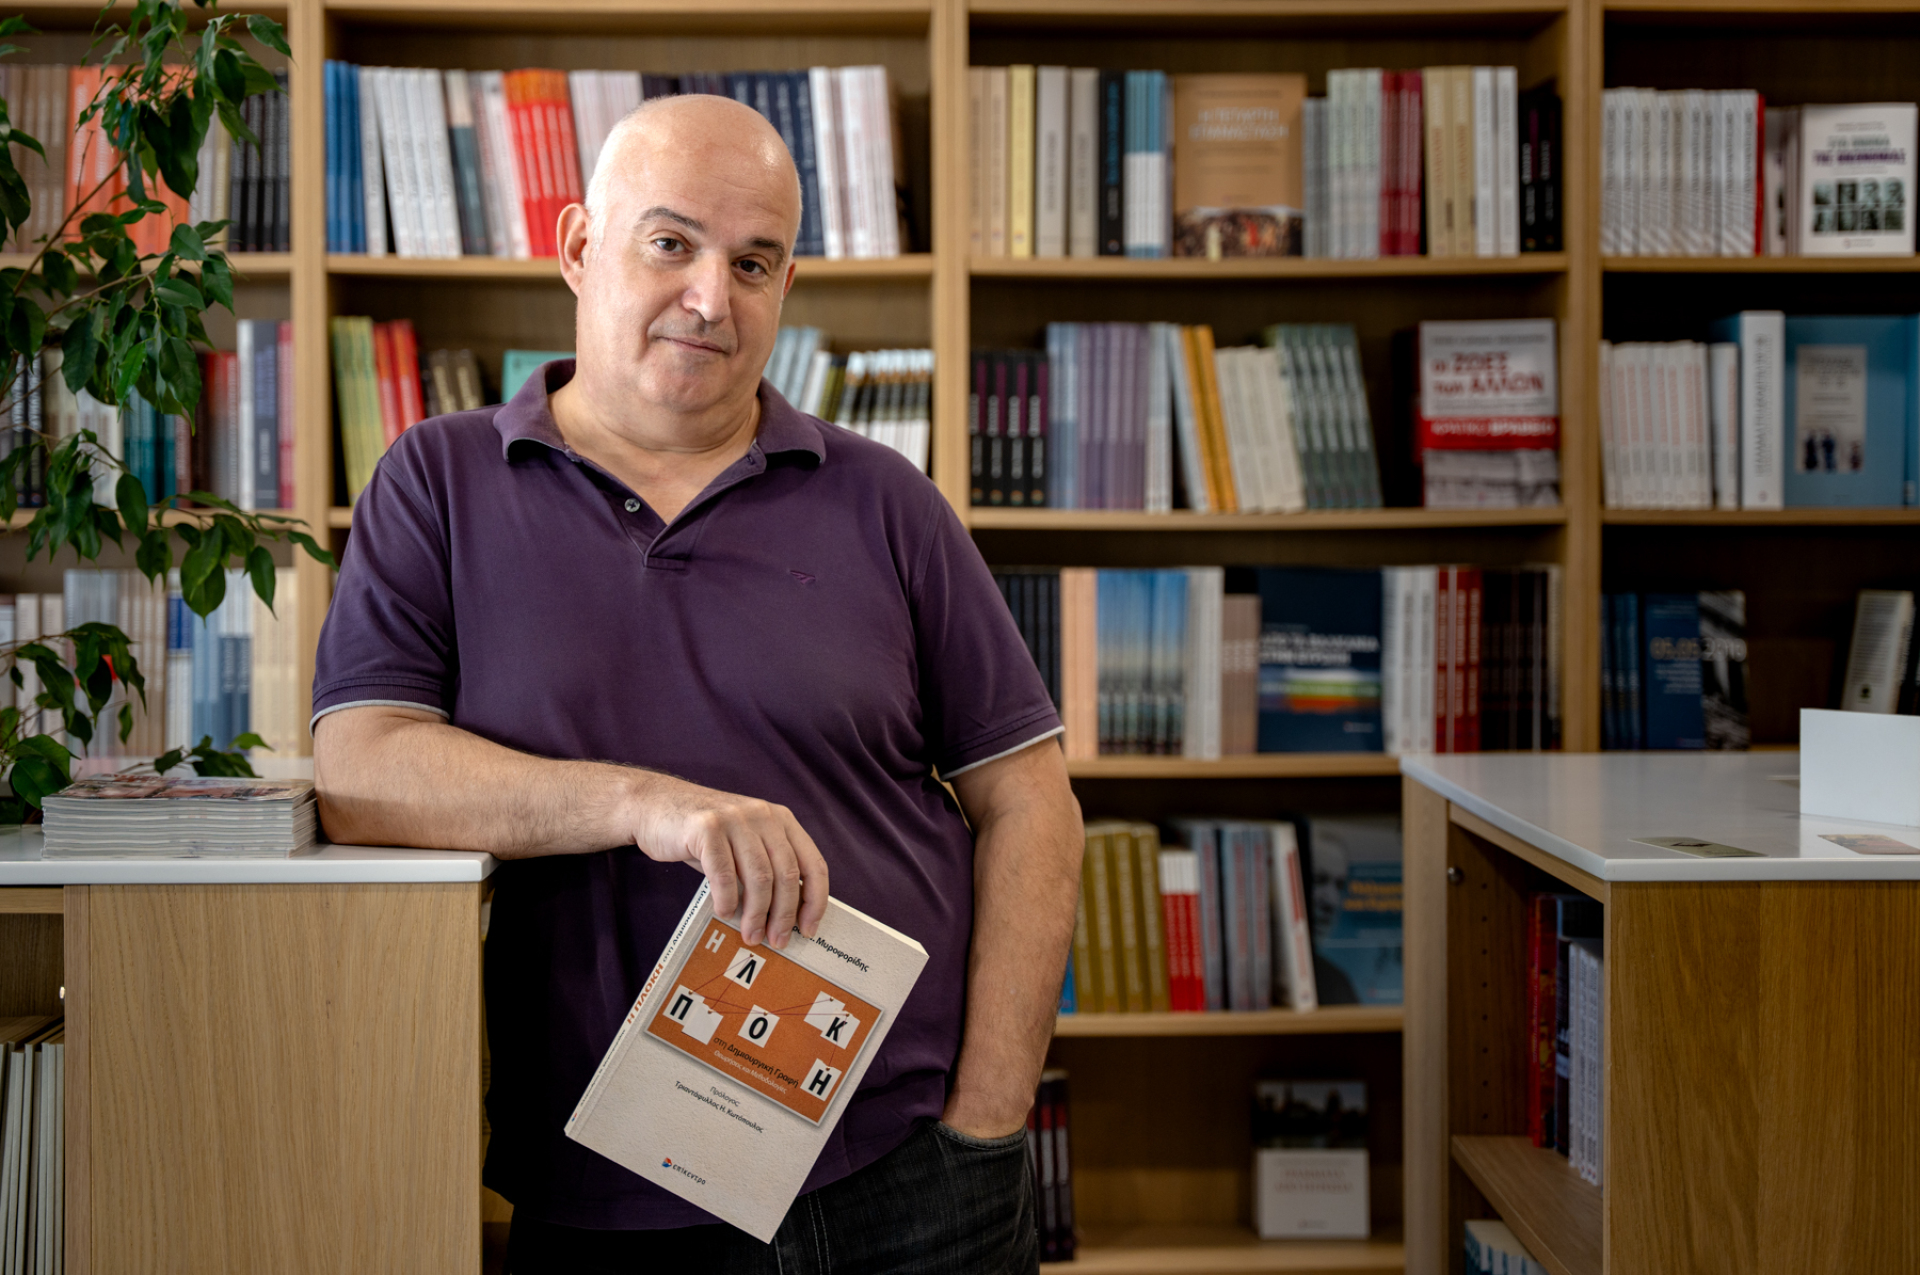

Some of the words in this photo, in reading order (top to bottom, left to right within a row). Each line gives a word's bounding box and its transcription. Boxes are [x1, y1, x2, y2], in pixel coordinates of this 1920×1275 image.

[1470, 371, 1544, 394] ΑΛΛΩΝ
[705, 929, 726, 954] Η
[815, 937, 869, 972] Μυροφορίδης
[736, 959, 757, 984] Λ
[627, 1012, 636, 1025] Η
[634, 963, 664, 1012] ΠΛΟΚΗ
[669, 993, 694, 1021] Π
[748, 1016, 769, 1040] Ο
[825, 1017, 848, 1042] Κ
[713, 1037, 728, 1049] στη
[727, 1044, 774, 1074] Δημιουργική
[774, 1068, 799, 1089] Γραφή
[742, 1065, 752, 1074] και
[751, 1069, 788, 1094] Μεθοδολογίες
[808, 1068, 832, 1096] Η
[675, 1080, 720, 1110] Τριαντάφυλλος
[726, 1108, 764, 1134] Κωτόπουλος
[709, 1086, 741, 1107] Πρόλογος
